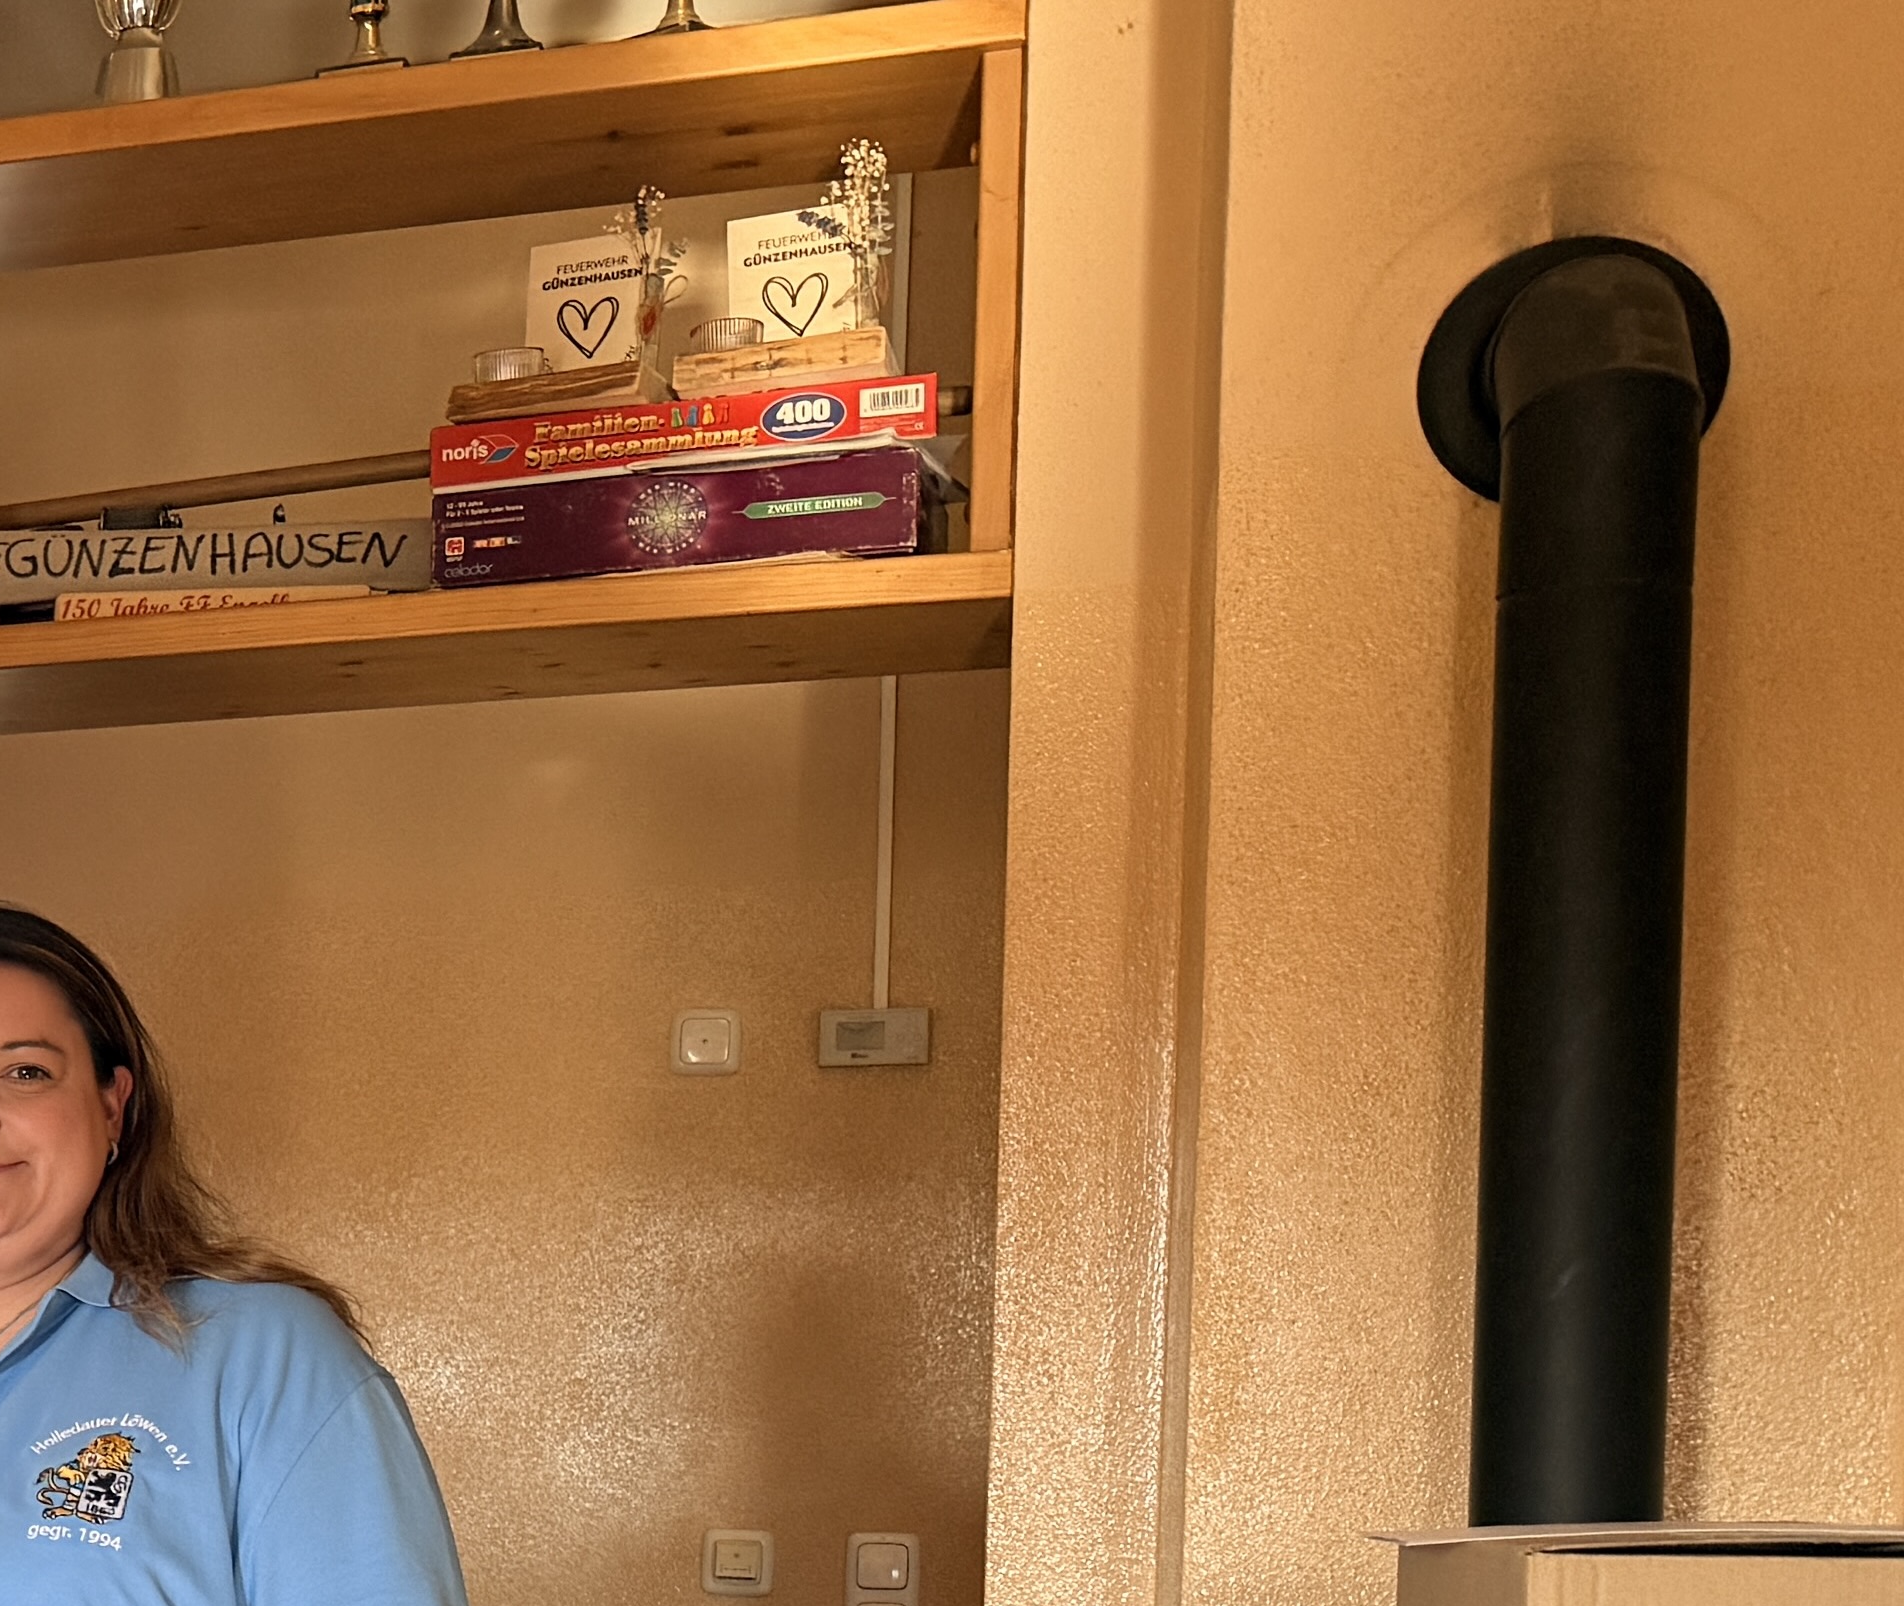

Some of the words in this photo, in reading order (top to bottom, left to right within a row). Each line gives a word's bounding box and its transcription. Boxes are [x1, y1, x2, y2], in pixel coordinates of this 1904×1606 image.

[556, 255, 629, 275] FEUERWEHR
[744, 242, 855, 267] GÜNZENHAUSEN
[542, 266, 644, 291] GÜNZENHAUSEN
[776, 398, 831, 425] 400
[442, 438, 489, 463] noris
[523, 424, 759, 470] Spielesammlung
[767, 501, 811, 515] ZWEITE
[815, 497, 863, 510] EDITION
[61, 598, 101, 620] 150
[111, 597, 170, 617] Jahre
[30, 1416, 118, 1455] Holledauer
[120, 1412, 168, 1443] Löwen
[164, 1443, 191, 1471] e.V.
[27, 1523, 72, 1540] gegr.
[78, 1528, 123, 1552] 1994
